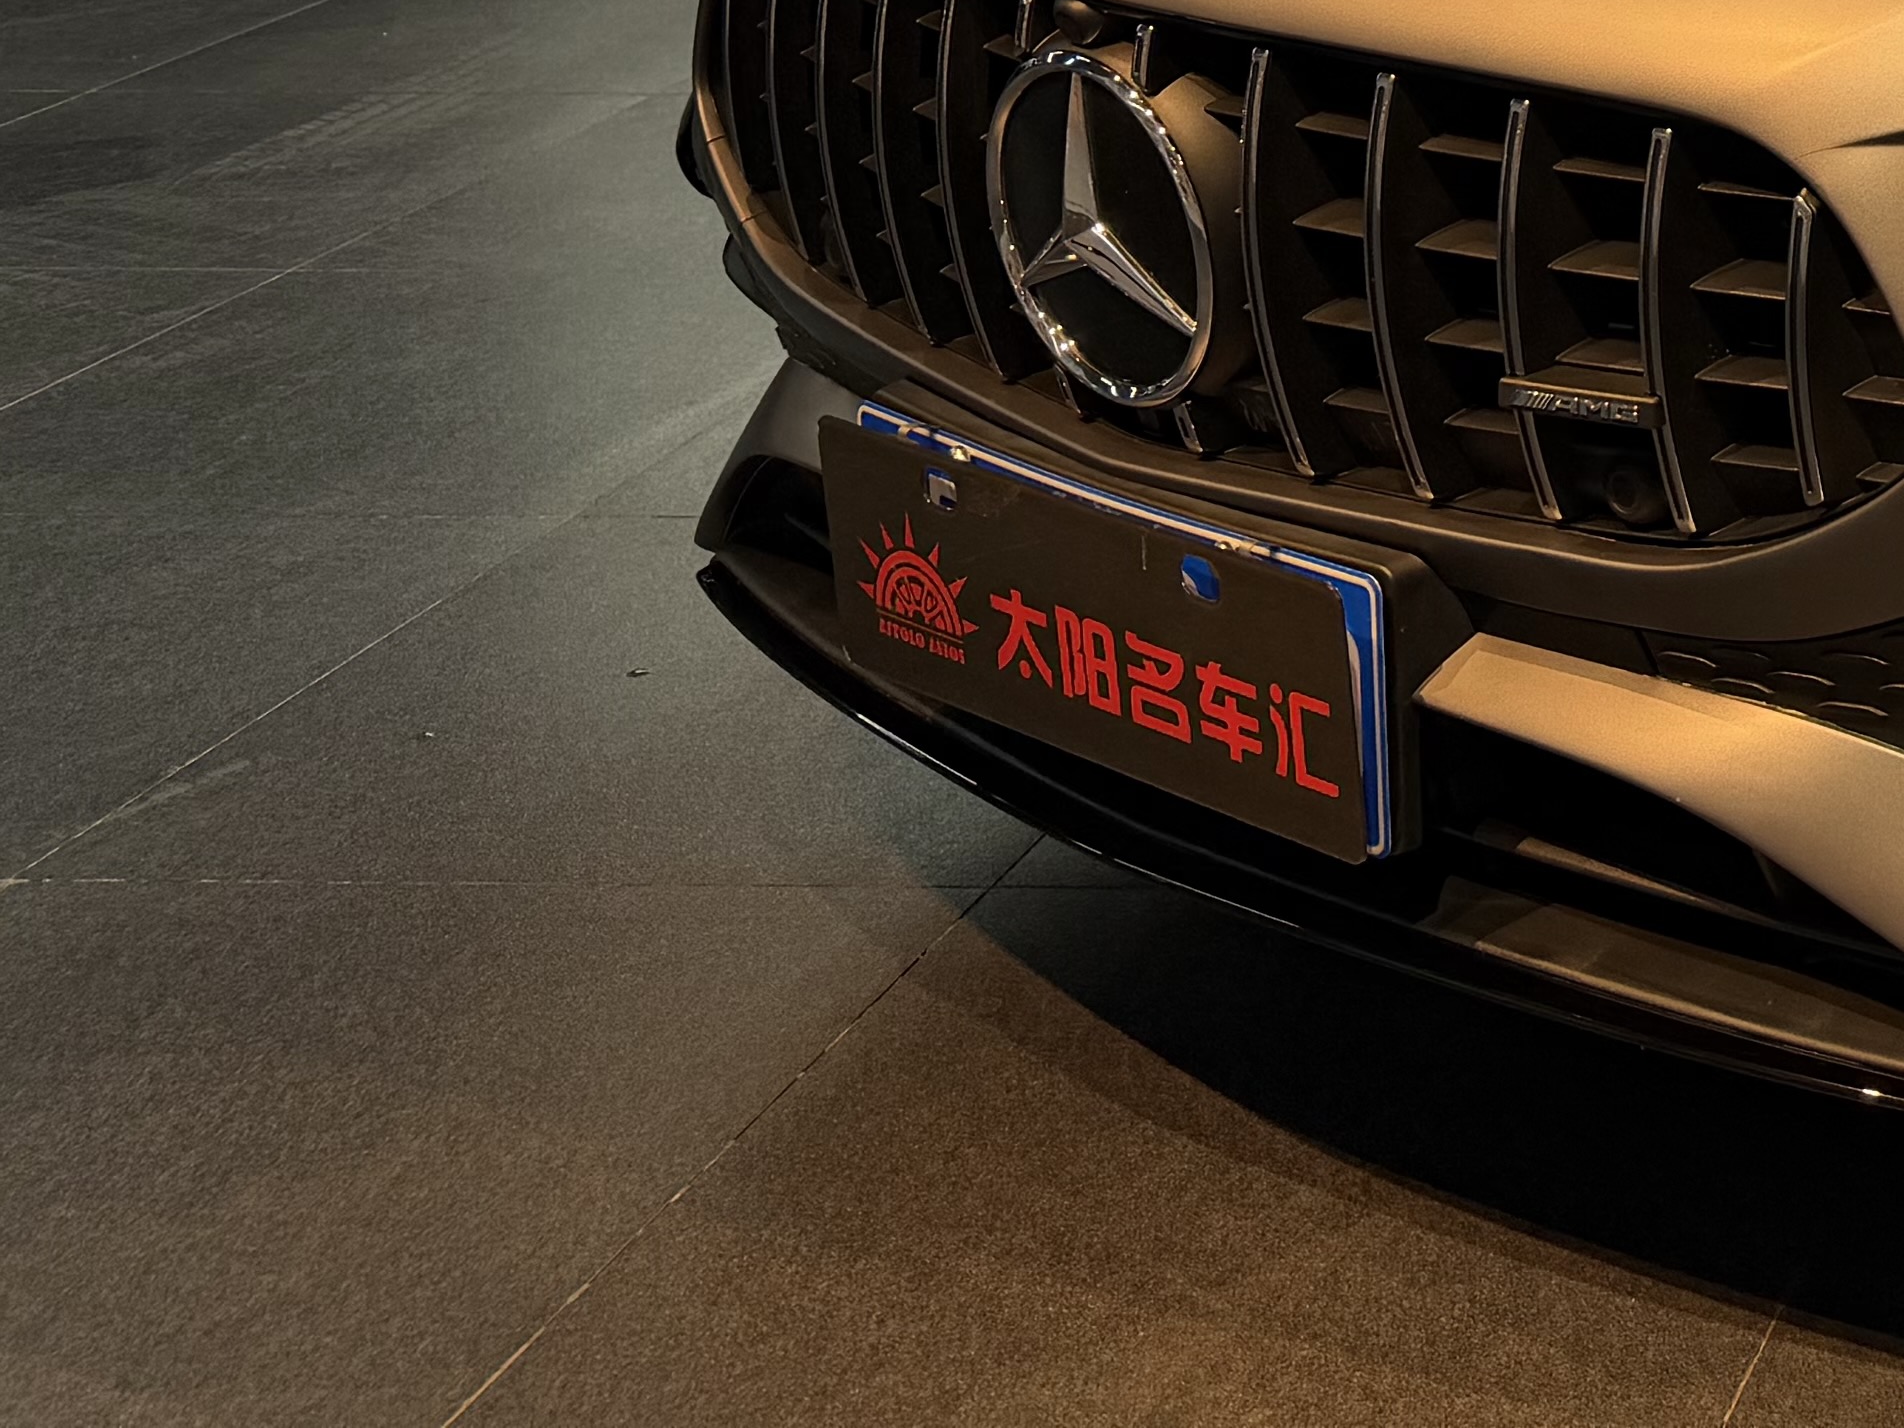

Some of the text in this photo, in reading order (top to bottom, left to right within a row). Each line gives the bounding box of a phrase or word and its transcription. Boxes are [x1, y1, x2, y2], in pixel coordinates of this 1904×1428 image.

[1553, 394, 1640, 424] AMG
[990, 588, 1339, 798] 太阳名车汇
